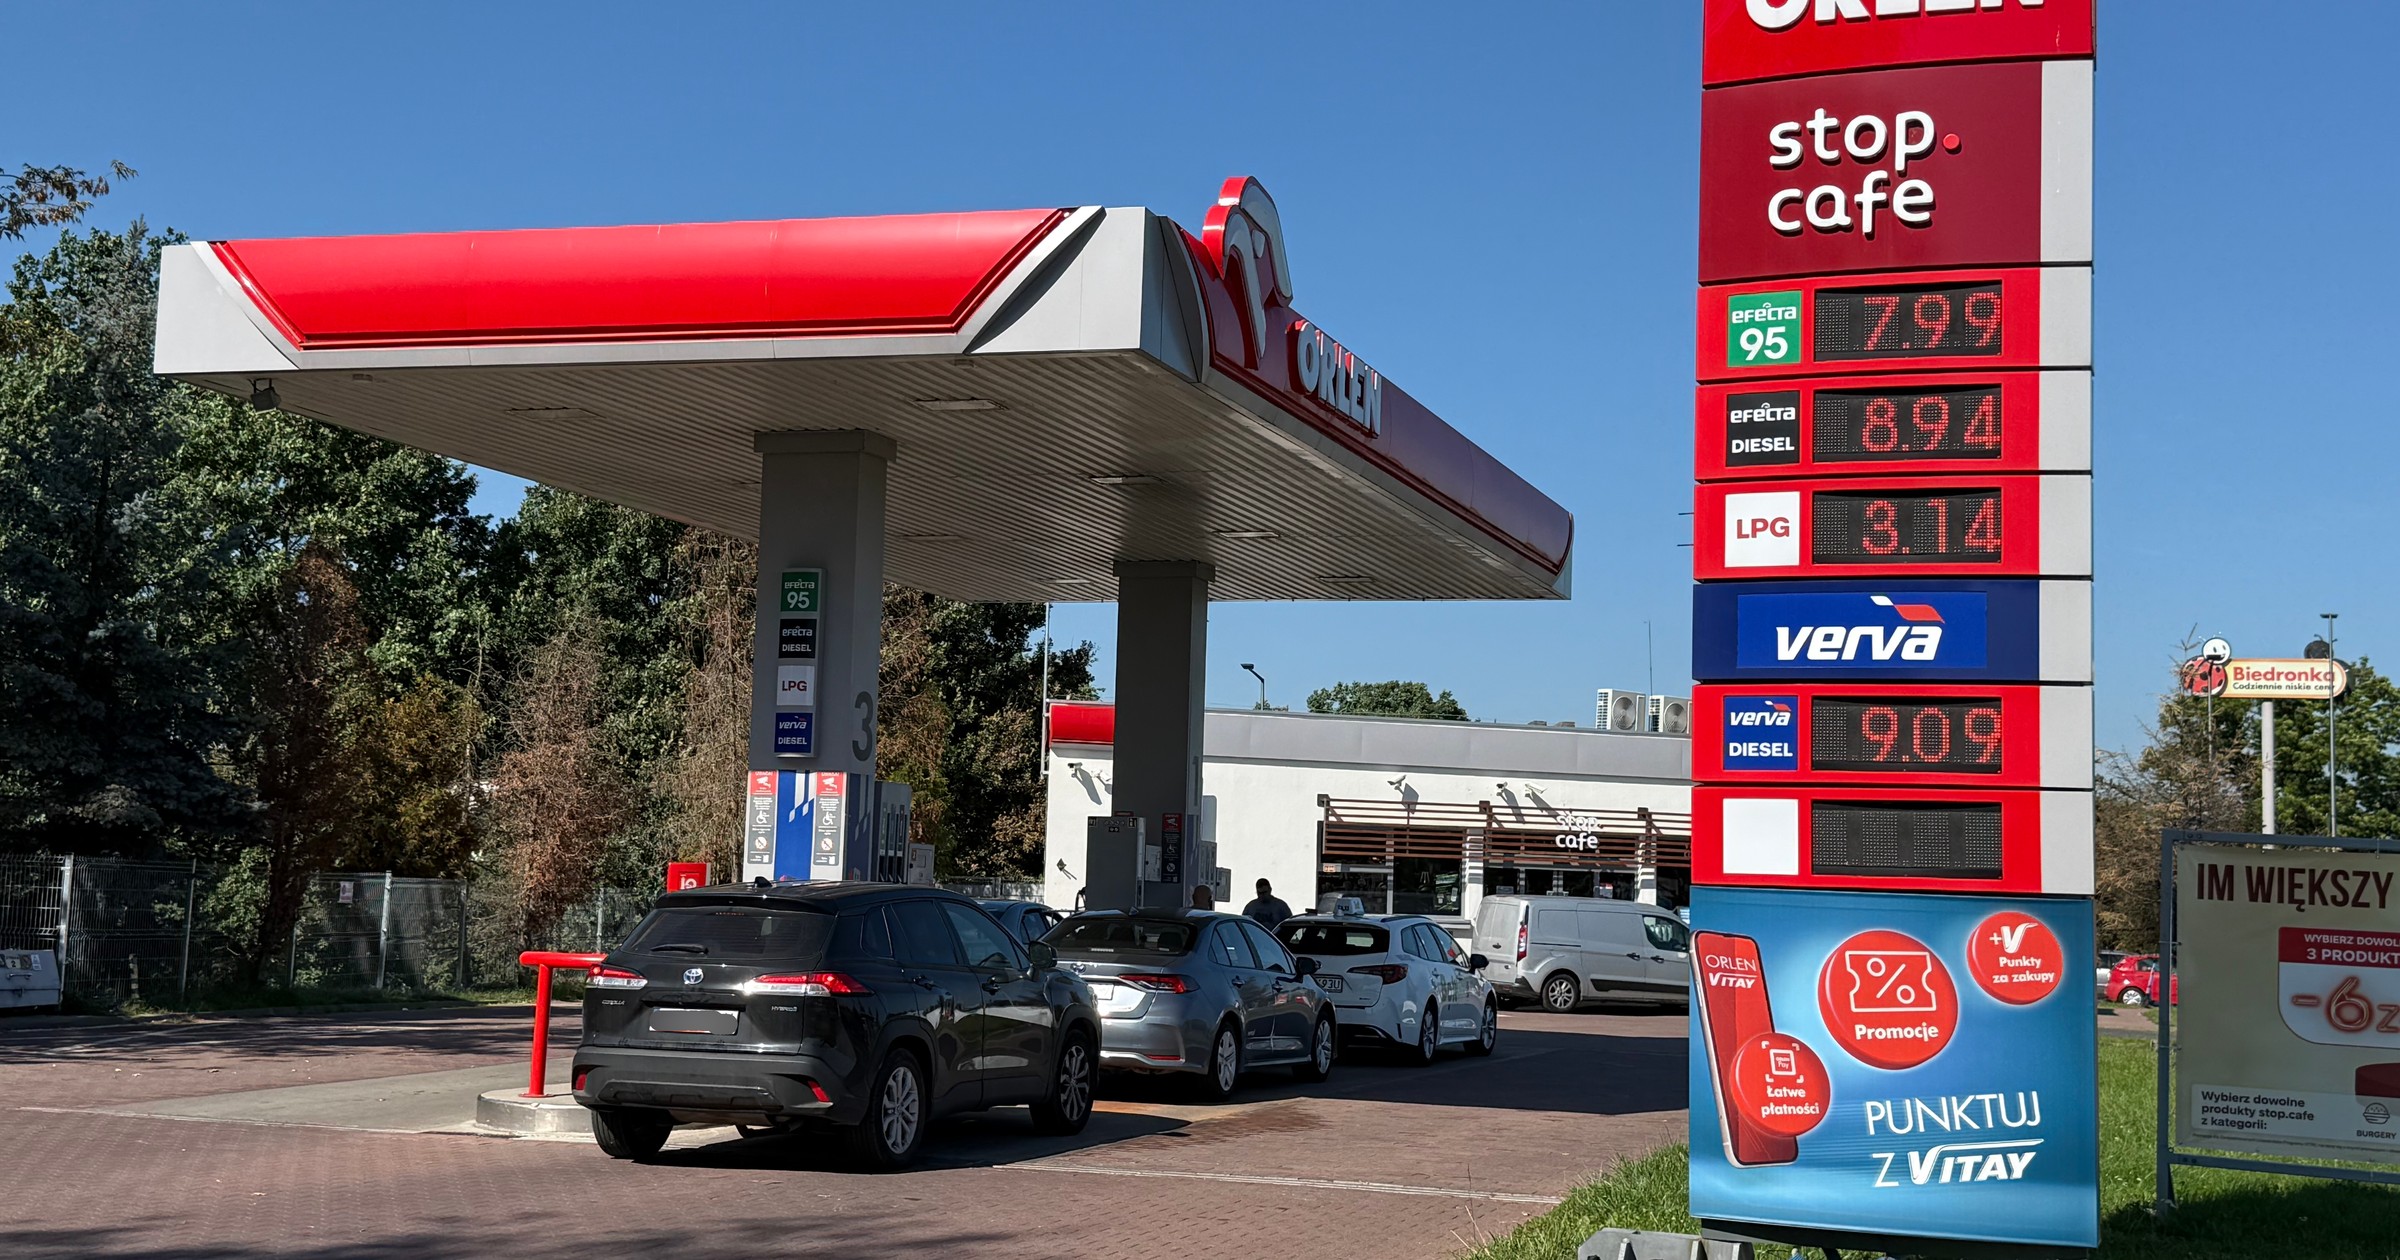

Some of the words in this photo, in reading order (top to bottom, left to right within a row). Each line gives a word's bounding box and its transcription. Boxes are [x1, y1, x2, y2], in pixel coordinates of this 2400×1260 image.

[1768, 171, 1935, 235] cafe
[1863, 292, 2001, 351] 7.99
[1740, 326, 1788, 361] 95
[1294, 320, 1382, 436] ORLEN
[1862, 395, 2001, 452] 8.94
[1731, 436, 1794, 453] DIESEL
[1736, 517, 1790, 539] LPG
[1862, 498, 2001, 554] 3.14
[787, 591, 810, 609] 95
[782, 644, 812, 652] DIESEL
[1776, 625, 1943, 661] verva
[2233, 666, 2336, 682] Biedronka
[782, 680, 807, 692] LPG
[2232, 682, 2283, 691] Codziennie
[779, 720, 807, 729] verva
[852, 691, 874, 762] 3
[1730, 709, 1792, 727] verva
[778, 737, 807, 745] DIESEL
[1862, 706, 2001, 763] 9.09
[1729, 742, 1793, 757] DIESEL
[1555, 832, 1599, 851] cafe
[2197, 863, 2234, 902] IM
[2245, 865, 2394, 912] WIĘKSZY
[2304, 934, 2354, 945] WYBIERZ
[2357, 936, 2400, 947] DOWOL
[1999, 955, 2042, 969] Punkty
[2306, 947, 2317, 960] 3
[1705, 954, 1756, 972] ORLEN
[1708, 972, 1757, 989] VITAY
[1992, 974, 2009, 984] za
[2012, 970, 2055, 983] zakupy
[1855, 1021, 1939, 1042] Promocje
[1766, 1085, 1806, 1098] Łatwe
[2201, 1091, 2250, 1104] Wybierz
[2253, 1094, 2305, 1108] dowolne
[1761, 1102, 1820, 1119] płatności
[1866, 1090, 2041, 1136] PUNKTUJ
[2201, 1104, 2255, 1118] produkty
[2258, 1108, 2315, 1121] stop.cafe
[2201, 1117, 2208, 1126] z
[2211, 1116, 2267, 1130] kategorii:
[2356, 1129, 2397, 1140] BURGERY
[1907, 1138, 2044, 1186] VITAY
